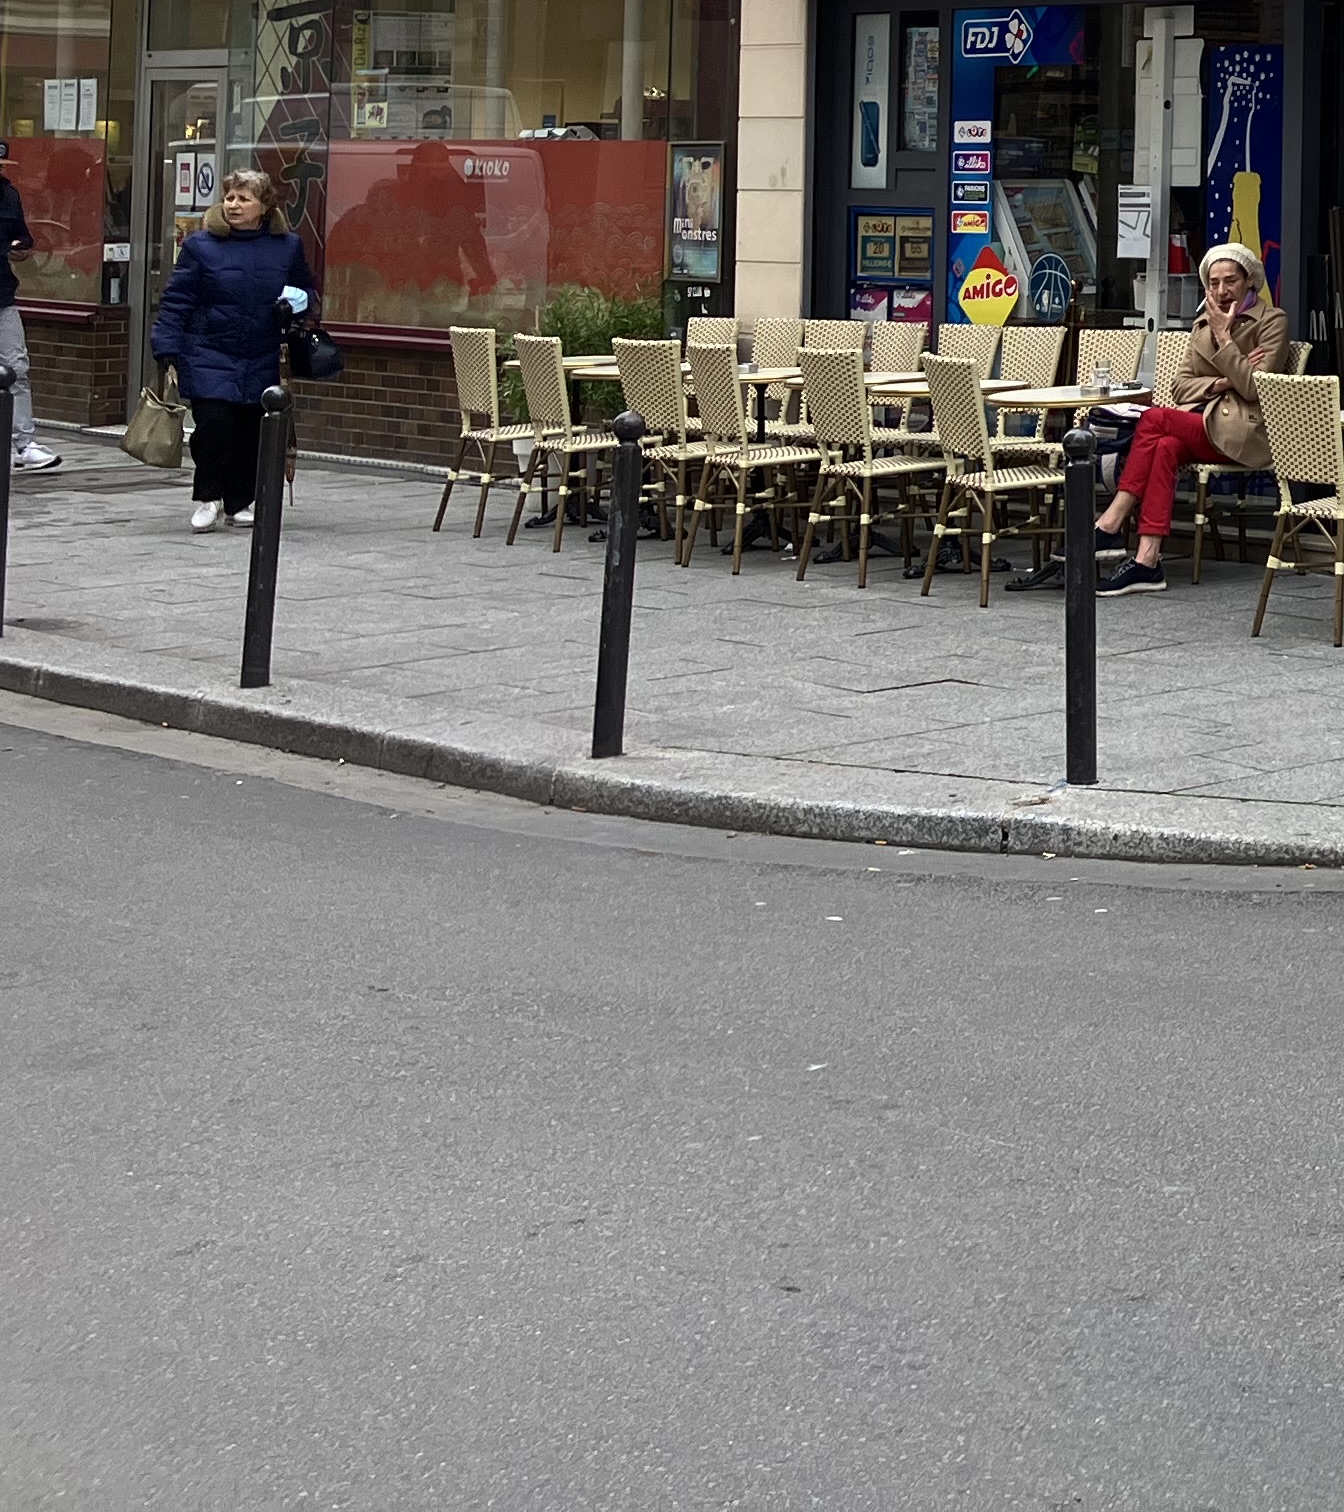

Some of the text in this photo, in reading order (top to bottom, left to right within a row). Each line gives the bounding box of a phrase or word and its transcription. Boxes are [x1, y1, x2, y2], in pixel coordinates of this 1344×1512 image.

[965, 27, 999, 49] FDJ
[474, 158, 510, 176] KIOKO
[963, 273, 1018, 301] AMIGO
